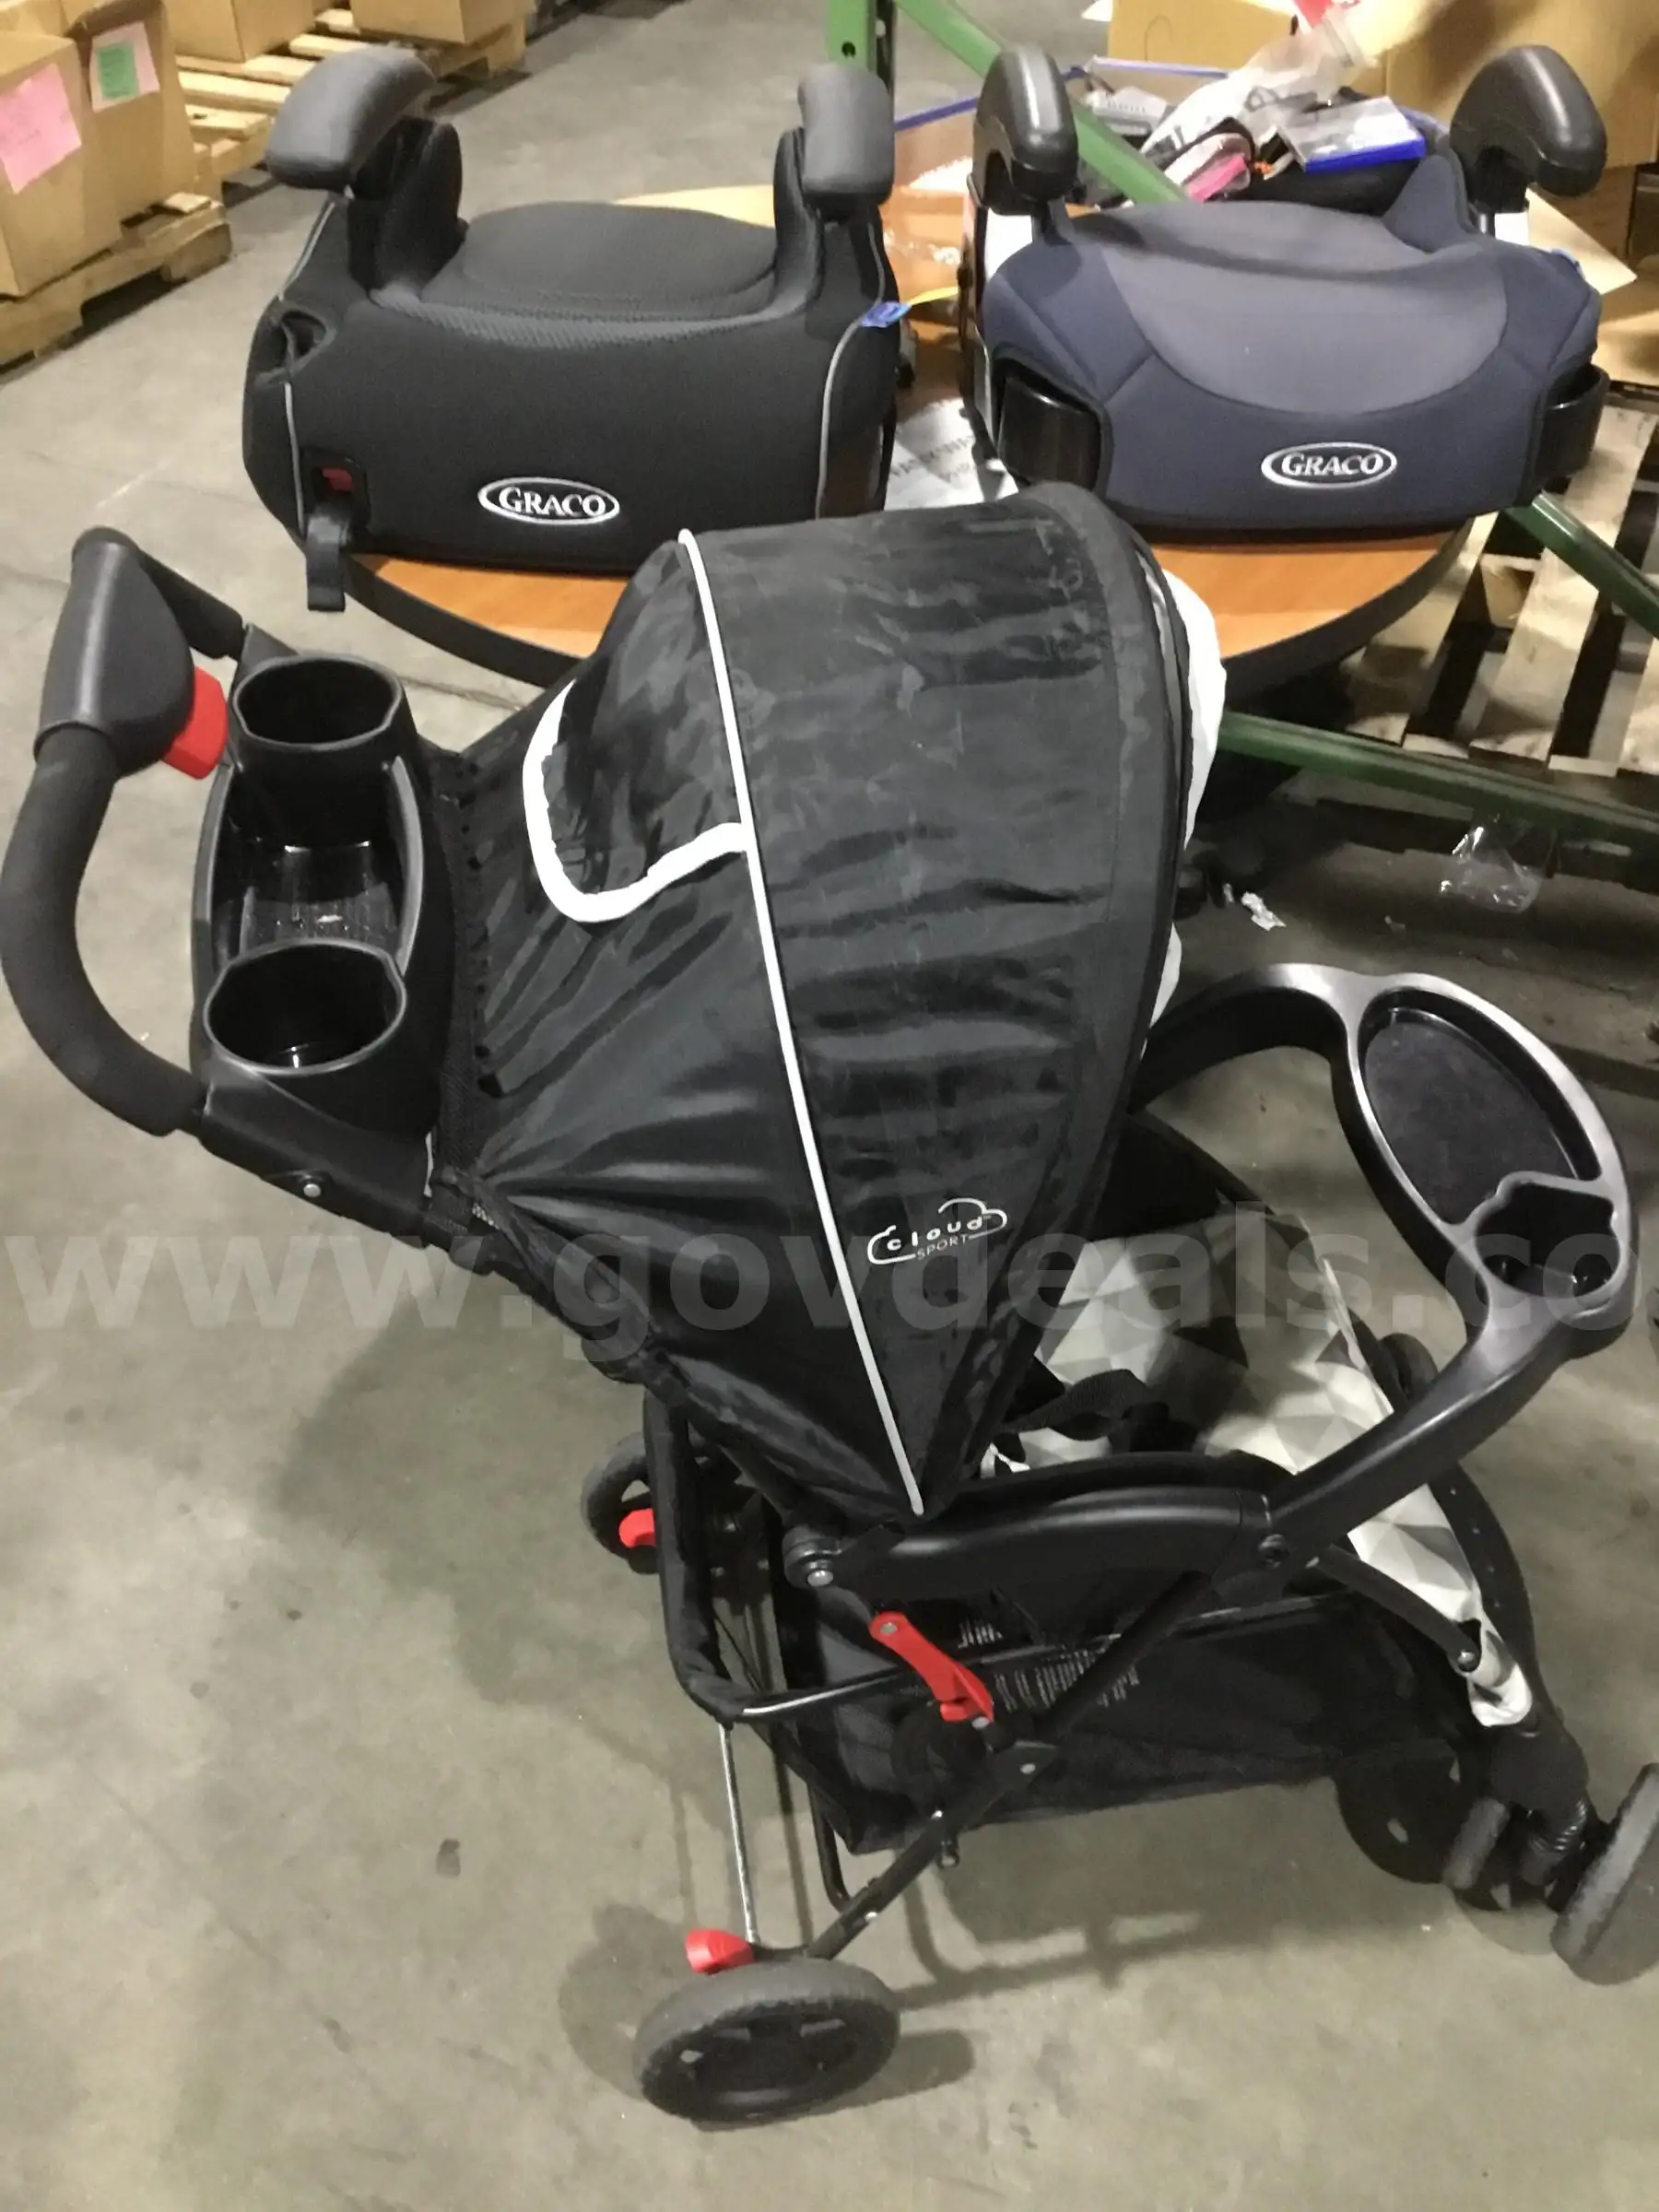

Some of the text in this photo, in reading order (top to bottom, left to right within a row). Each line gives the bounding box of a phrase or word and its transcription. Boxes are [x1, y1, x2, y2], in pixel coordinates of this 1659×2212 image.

[1281, 452, 1384, 477] GRACO
[498, 486, 606, 517] GRACO
[916, 1233, 968, 1260] SPORT
